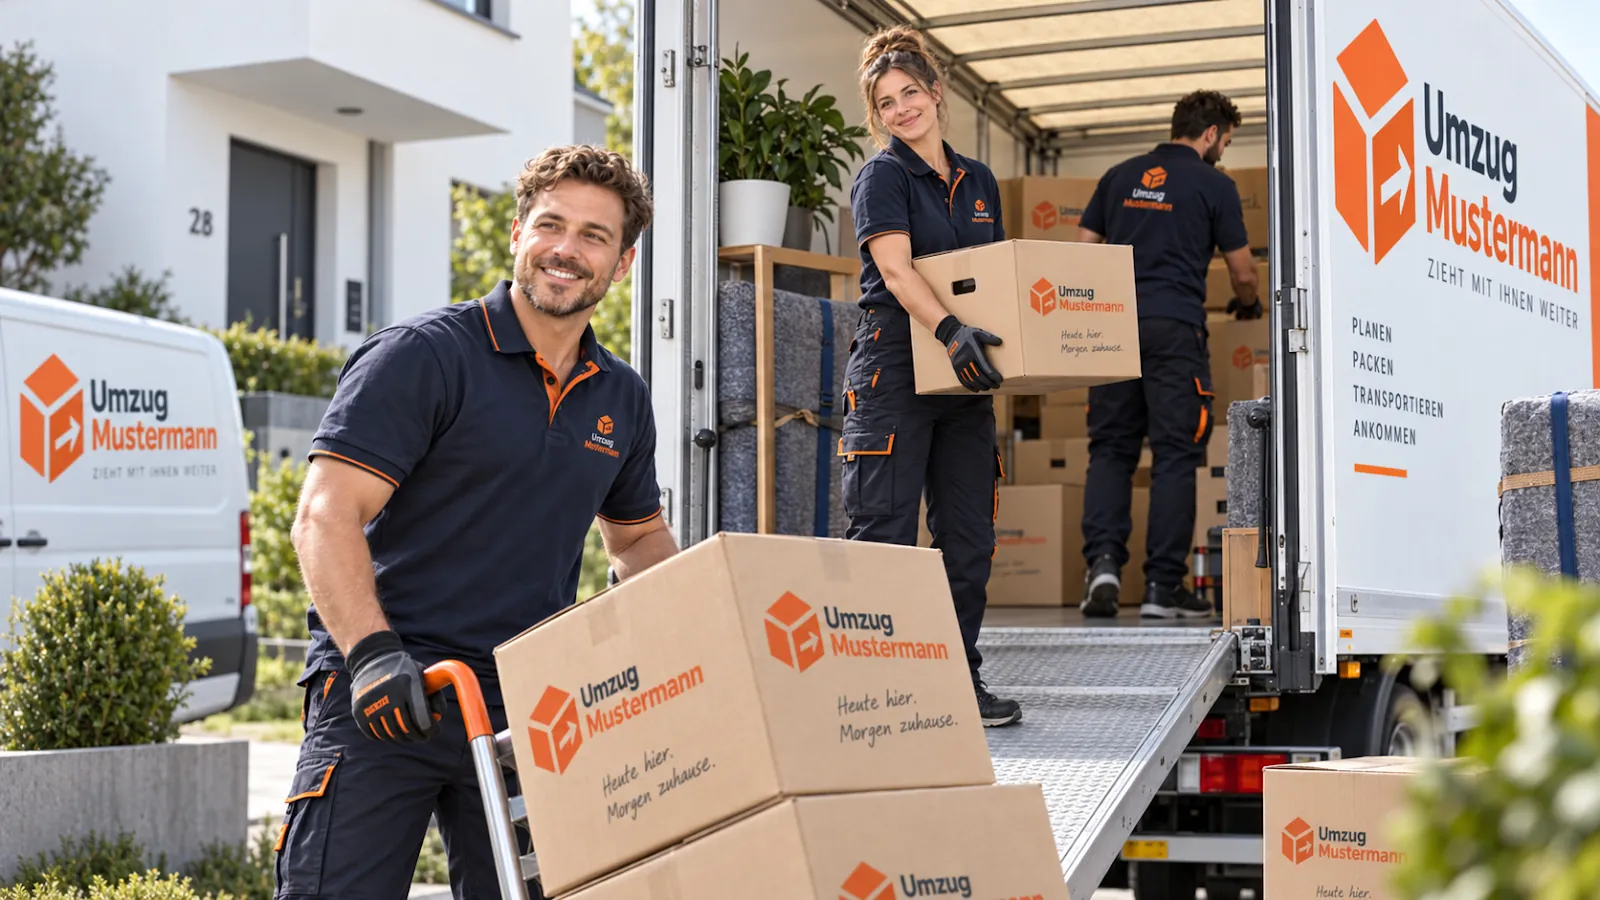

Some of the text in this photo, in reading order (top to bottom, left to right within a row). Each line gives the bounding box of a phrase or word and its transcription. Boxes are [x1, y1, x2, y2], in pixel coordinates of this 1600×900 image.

[1423, 81, 1518, 204] Umzug
[189, 207, 213, 237] 28
[1425, 165, 1578, 294] Mustermann
[1058, 285, 1094, 300] Umzug
[1059, 299, 1124, 313] Mustermann
[1428, 258, 1578, 330] ZIEHT MIT IHNEN WEITER
[1352, 316, 1392, 343] PLANEN
[1353, 351, 1394, 376] PACKEN
[90, 379, 168, 421] Umzug
[1353, 385, 1444, 419] TRANSPORTIEREN
[92, 418, 217, 451] Mustermann
[1353, 419, 1416, 445] ANKOMMEN
[93, 466, 122, 480] ZIEHT
[127, 466, 145, 478] MIT
[823, 606, 894, 636] Umzug
[830, 633, 949, 660] Mustermann
[580, 665, 640, 708] Umzug
[585, 664, 704, 739] Mustermann
[837, 688, 917, 717] Heute hier.
[839, 712, 958, 748] Morgen zuhause.
[602, 747, 674, 798] Heute hier.
[607, 757, 716, 824] Morgen zuhause.
[1318, 826, 1366, 846] Umzug
[900, 874, 972, 898] Umzug
[1316, 885, 1371, 899] Heute hier.
